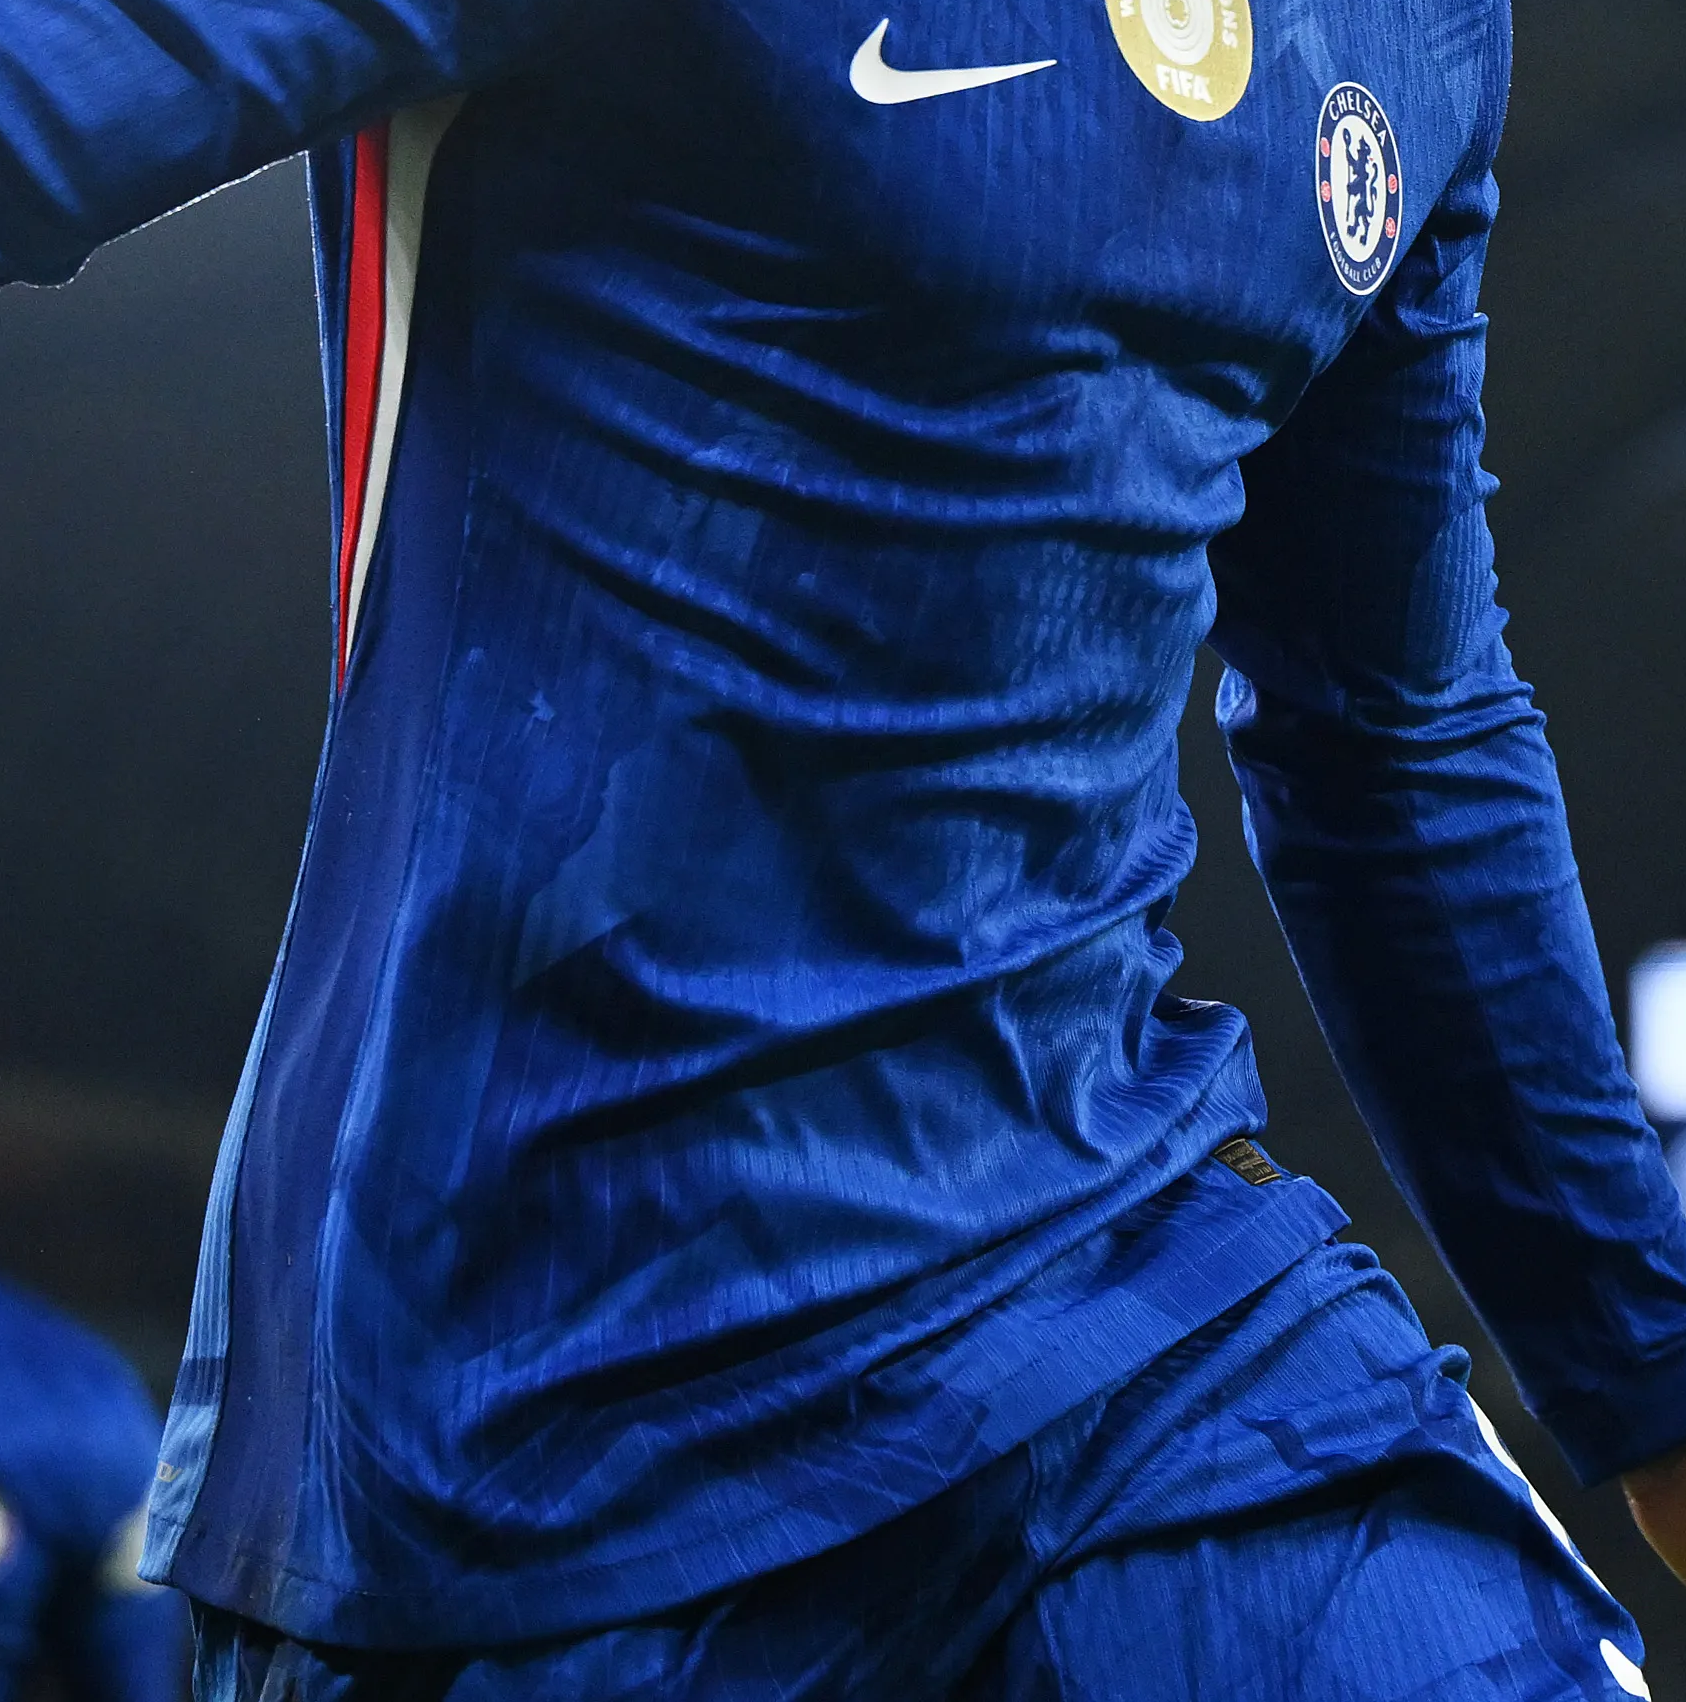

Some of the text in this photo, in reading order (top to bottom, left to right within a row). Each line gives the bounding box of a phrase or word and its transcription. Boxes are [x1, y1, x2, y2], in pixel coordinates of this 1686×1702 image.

[1156, 64, 1212, 104] FIFA
[1329, 91, 1387, 147] CHELSEA
[1330, 231, 1382, 283] FOOTBALL CLUB
